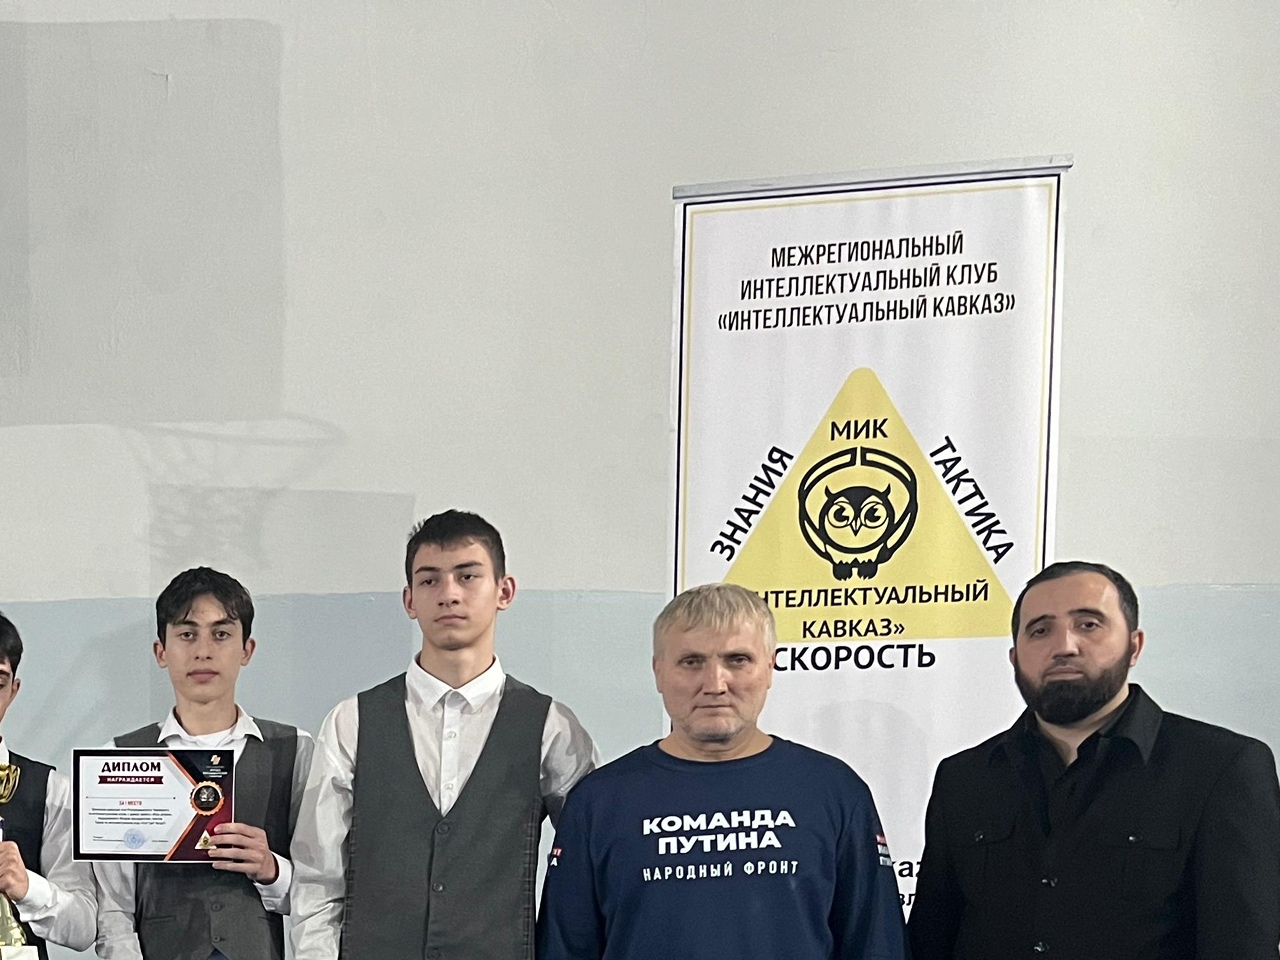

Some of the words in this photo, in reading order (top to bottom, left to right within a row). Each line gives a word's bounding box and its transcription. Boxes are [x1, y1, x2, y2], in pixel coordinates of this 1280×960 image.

[771, 230, 964, 268] МЕЖРЕГИОНАЛЬНЫЙ
[740, 264, 940, 300] ИНТЕЛЛЕКТУАЛЬНЫЙ
[946, 262, 998, 286] КЛУБ
[718, 295, 928, 331] «ИНТЕЛЛЕКТУАЛЬНЫЙ
[933, 292, 1016, 317] КАВКАЗ»
[830, 418, 888, 441] МИК
[710, 446, 795, 562] ЗНАНИЯ
[929, 435, 1015, 564] ТАКТИКА
[755, 579, 989, 609] ТЕЛЛЕКТУАЛЬНЫЙ
[802, 618, 905, 639] КАВКАЗ»
[774, 643, 936, 672] СКОРОСТЬ
[101, 761, 161, 773] ДИПЛОМ
[643, 809, 796, 835] КОМАНДА
[658, 831, 782, 855] ПУТИНА
[643, 861, 733, 882] НАРОДНЫЙ
[743, 860, 799, 877] ФРОНТ
